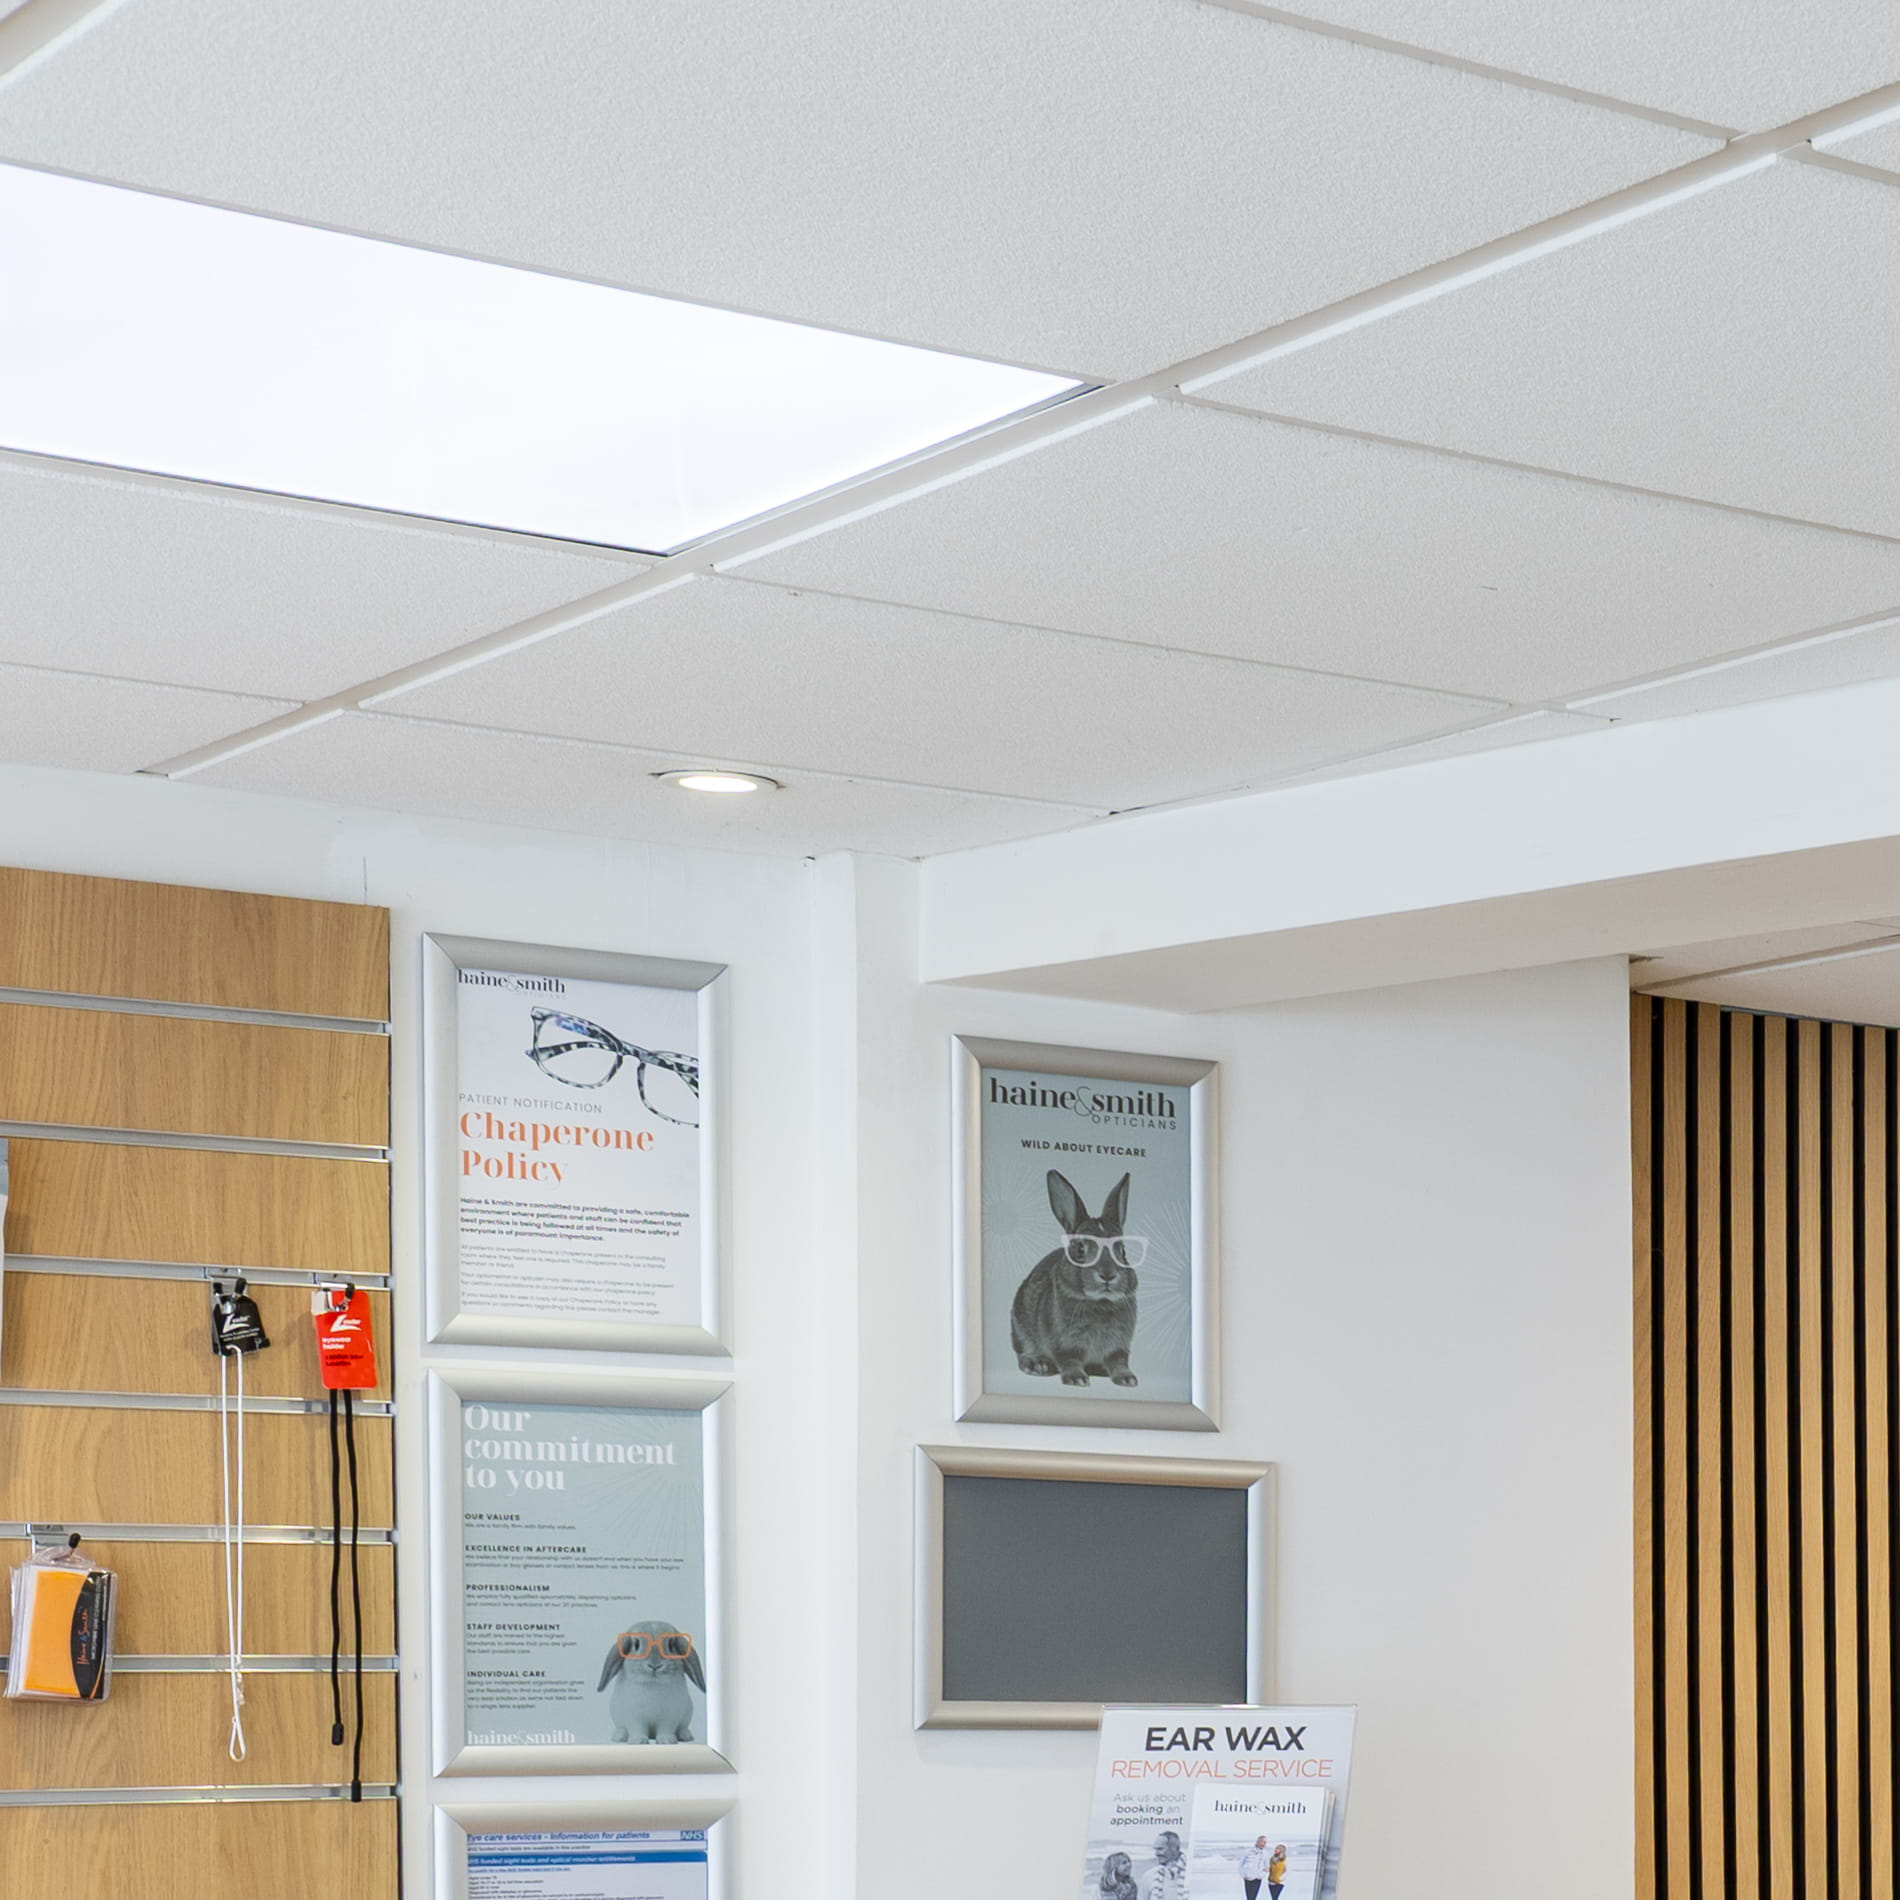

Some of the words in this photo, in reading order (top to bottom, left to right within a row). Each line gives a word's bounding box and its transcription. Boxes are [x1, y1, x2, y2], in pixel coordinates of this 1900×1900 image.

[458, 1093, 510, 1108] PATIENT
[513, 1097, 603, 1113] NOTIFICATION
[459, 1110, 655, 1152] Chaperone
[1091, 1114, 1177, 1131] OPTICIANS
[1021, 1139, 1050, 1152] WILD
[1054, 1141, 1093, 1153] ABOUT
[1096, 1144, 1147, 1158] EYECARE
[460, 1149, 568, 1190] Policy
[463, 1403, 532, 1433] Our
[463, 1435, 676, 1466] commitment
[465, 1464, 497, 1490] to
[505, 1468, 566, 1497] you
[464, 1512, 484, 1521] OUR
[486, 1513, 521, 1521] VALUES
[464, 1544, 521, 1553] EXCELLENCE
[522, 1545, 534, 1553] IN
[535, 1546, 587, 1554] AFTERCARE
[465, 1583, 551, 1592] PROFESSIONALISM
[466, 1623, 493, 1631] STAFF
[467, 1670, 520, 1678] INDIVIDUAL
[522, 1670, 546, 1678] CARE
[1144, 1726, 1216, 1752] EAR
[1224, 1725, 1308, 1751] WAX
[1110, 1759, 1228, 1779] REMOVAL
[1233, 1758, 1335, 1779] SERVICE
[1113, 1791, 1134, 1803] Ask
[1137, 1794, 1152, 1803] us
[1153, 1791, 1187, 1803] about
[1115, 1803, 1164, 1816] booking
[1110, 1814, 1185, 1827] appointment
[505, 1833, 543, 1842] services
[550, 1831, 596, 1841] Information
[602, 1831, 614, 1840] for
[615, 1831, 651, 1841] patients
[681, 1831, 704, 1841] NHS
